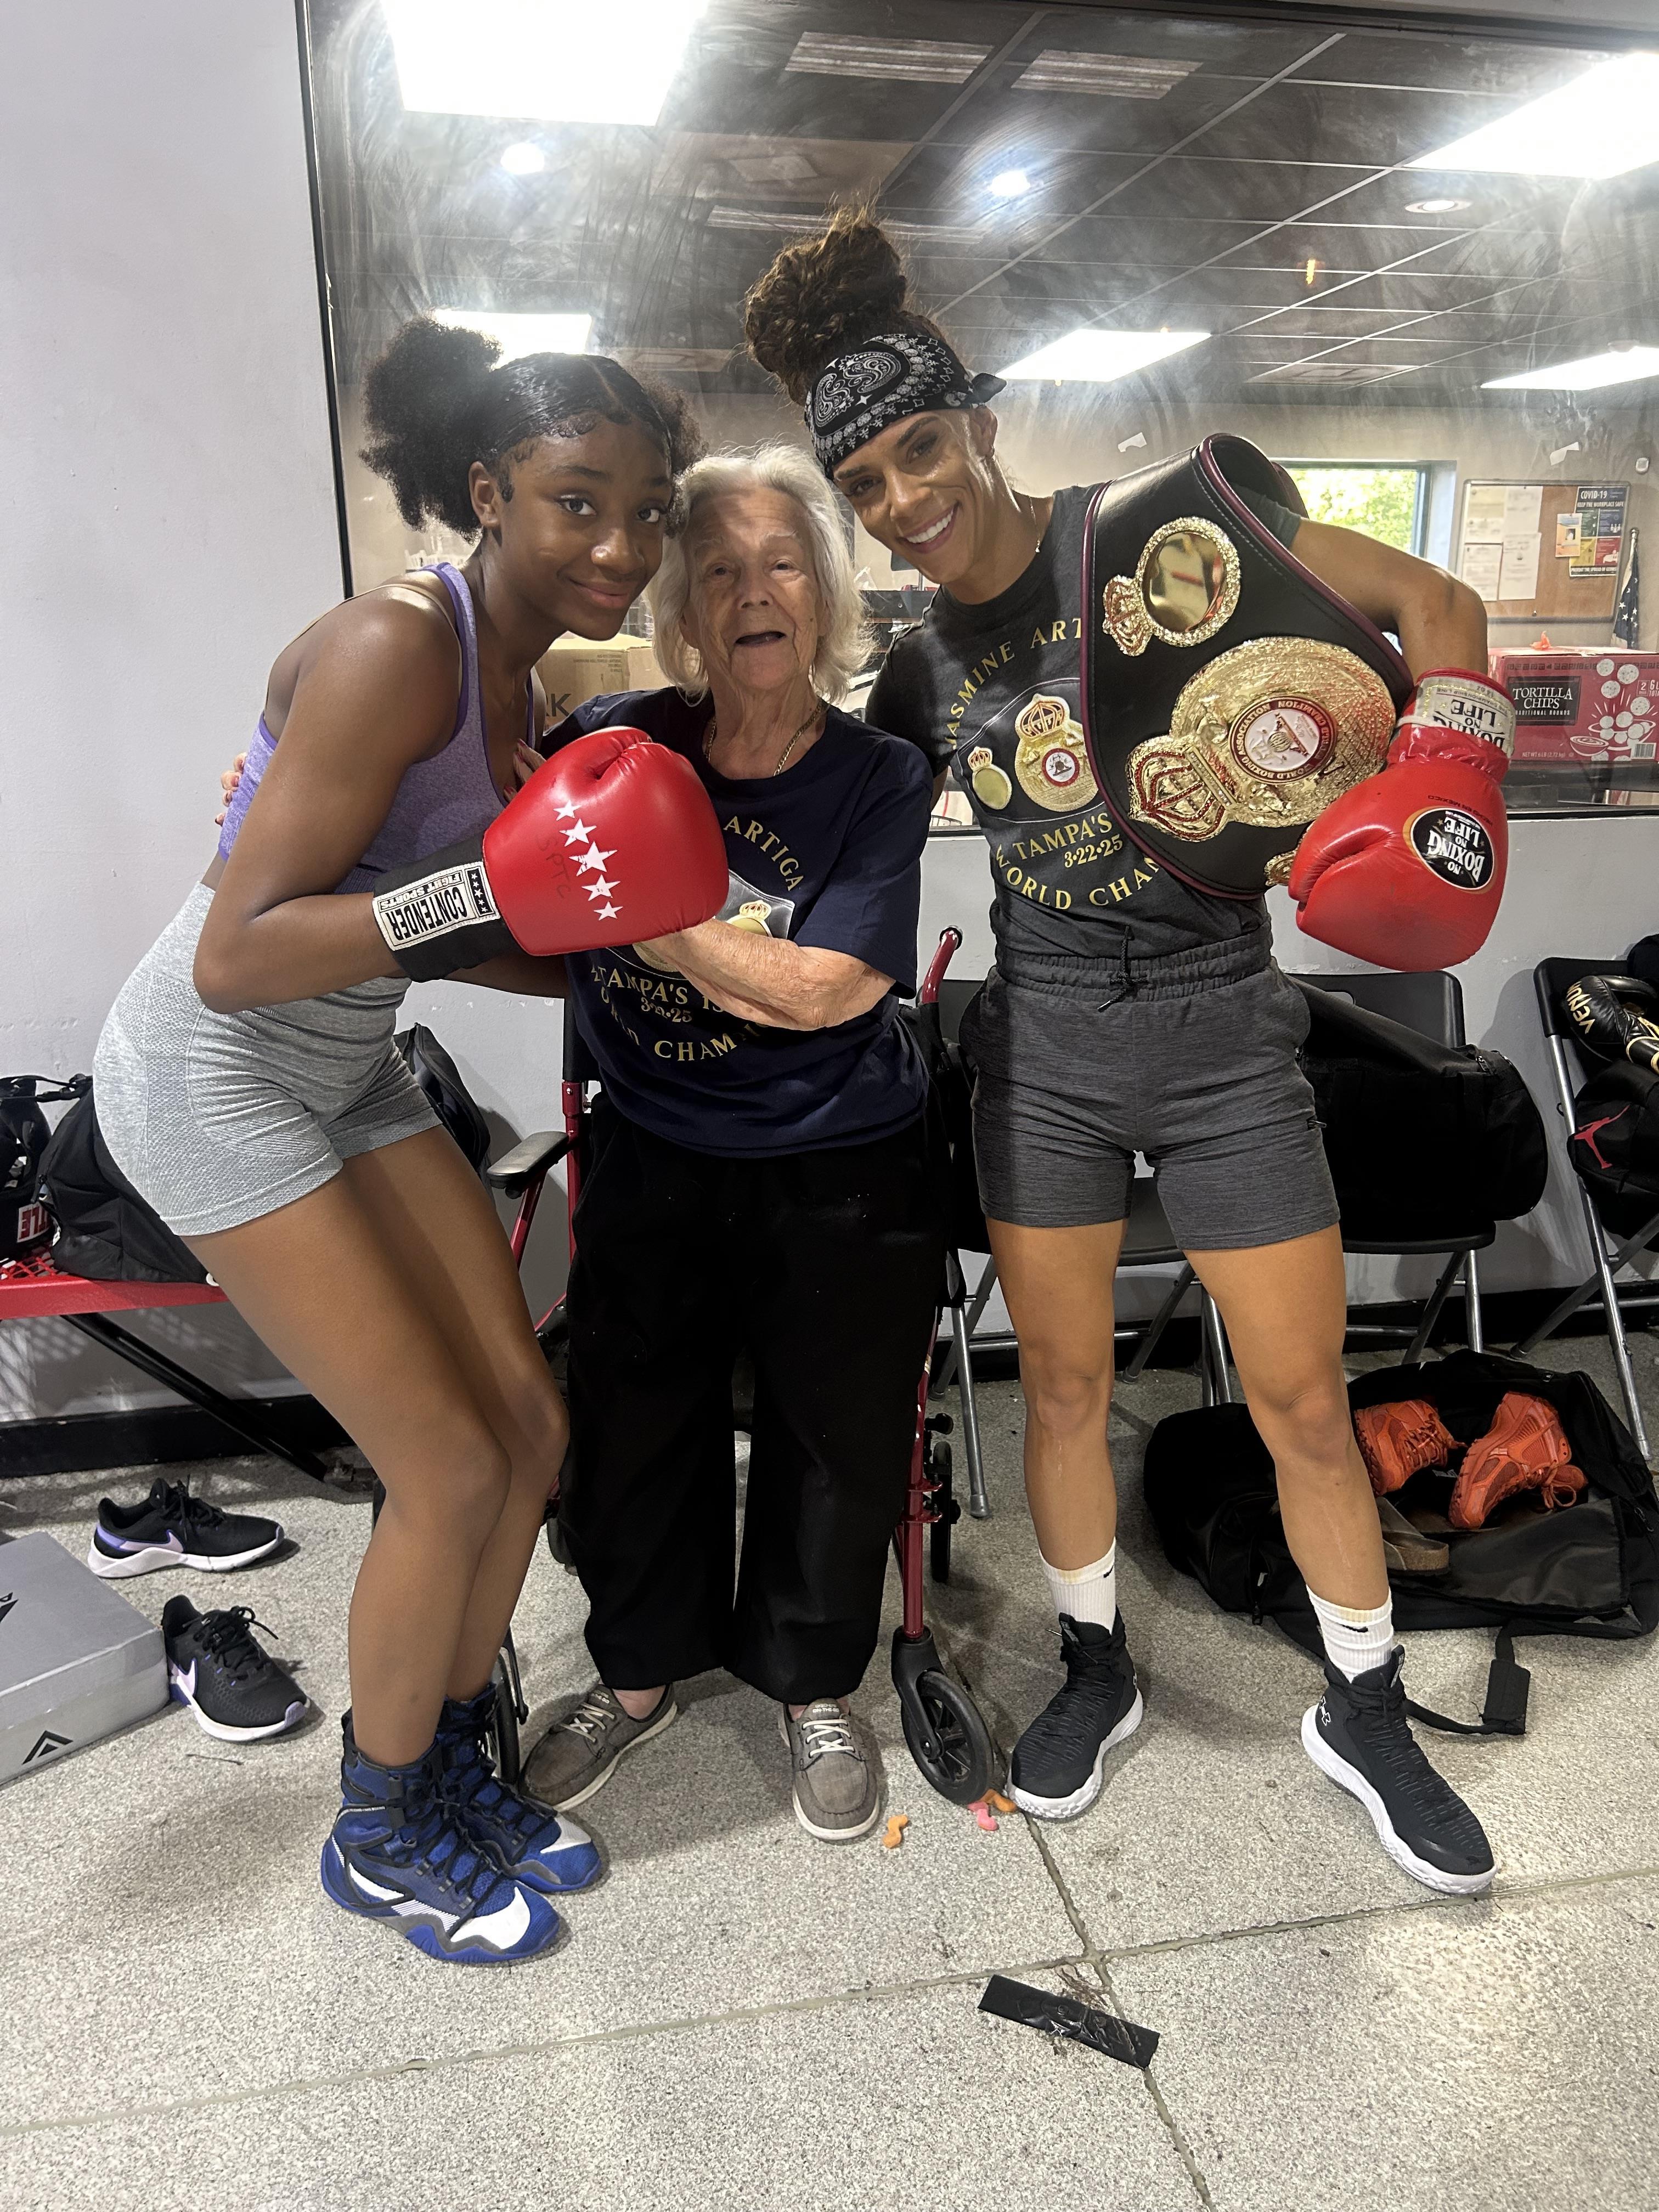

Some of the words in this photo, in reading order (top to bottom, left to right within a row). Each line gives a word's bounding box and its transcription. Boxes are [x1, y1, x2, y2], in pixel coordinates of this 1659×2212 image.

[1581, 490, 1607, 499] COVID-19
[945, 641, 1015, 750] JASMINE
[1513, 687, 1573, 701] TORTILLA
[1640, 682, 1646, 690] 2
[1650, 680, 1655, 690] 6
[546, 693, 572, 716] K
[1277, 701, 1327, 726] CHAMPION
[1451, 699, 1497, 727] LIFE
[1523, 698, 1560, 709] CHIPS
[1236, 703, 1272, 756] ASSOCIATION
[1464, 717, 1481, 729] NO
[1241, 757, 1274, 779] BOXING
[1427, 795, 1461, 808] MEXICO
[1013, 812, 1113, 860] TAMPA'S
[1444, 816, 1481, 848] LIFE
[1455, 836, 1468, 848] NO
[723, 816, 805, 892] ARTIGA
[1427, 830, 1485, 883] BOXING
[1447, 861, 1462, 876] NO
[426, 872, 461, 893] FIGHT
[381, 887, 425, 910] SPORTS
[385, 887, 468, 941] CONTENDER
[598, 966, 688, 1005] TAMPA'S
